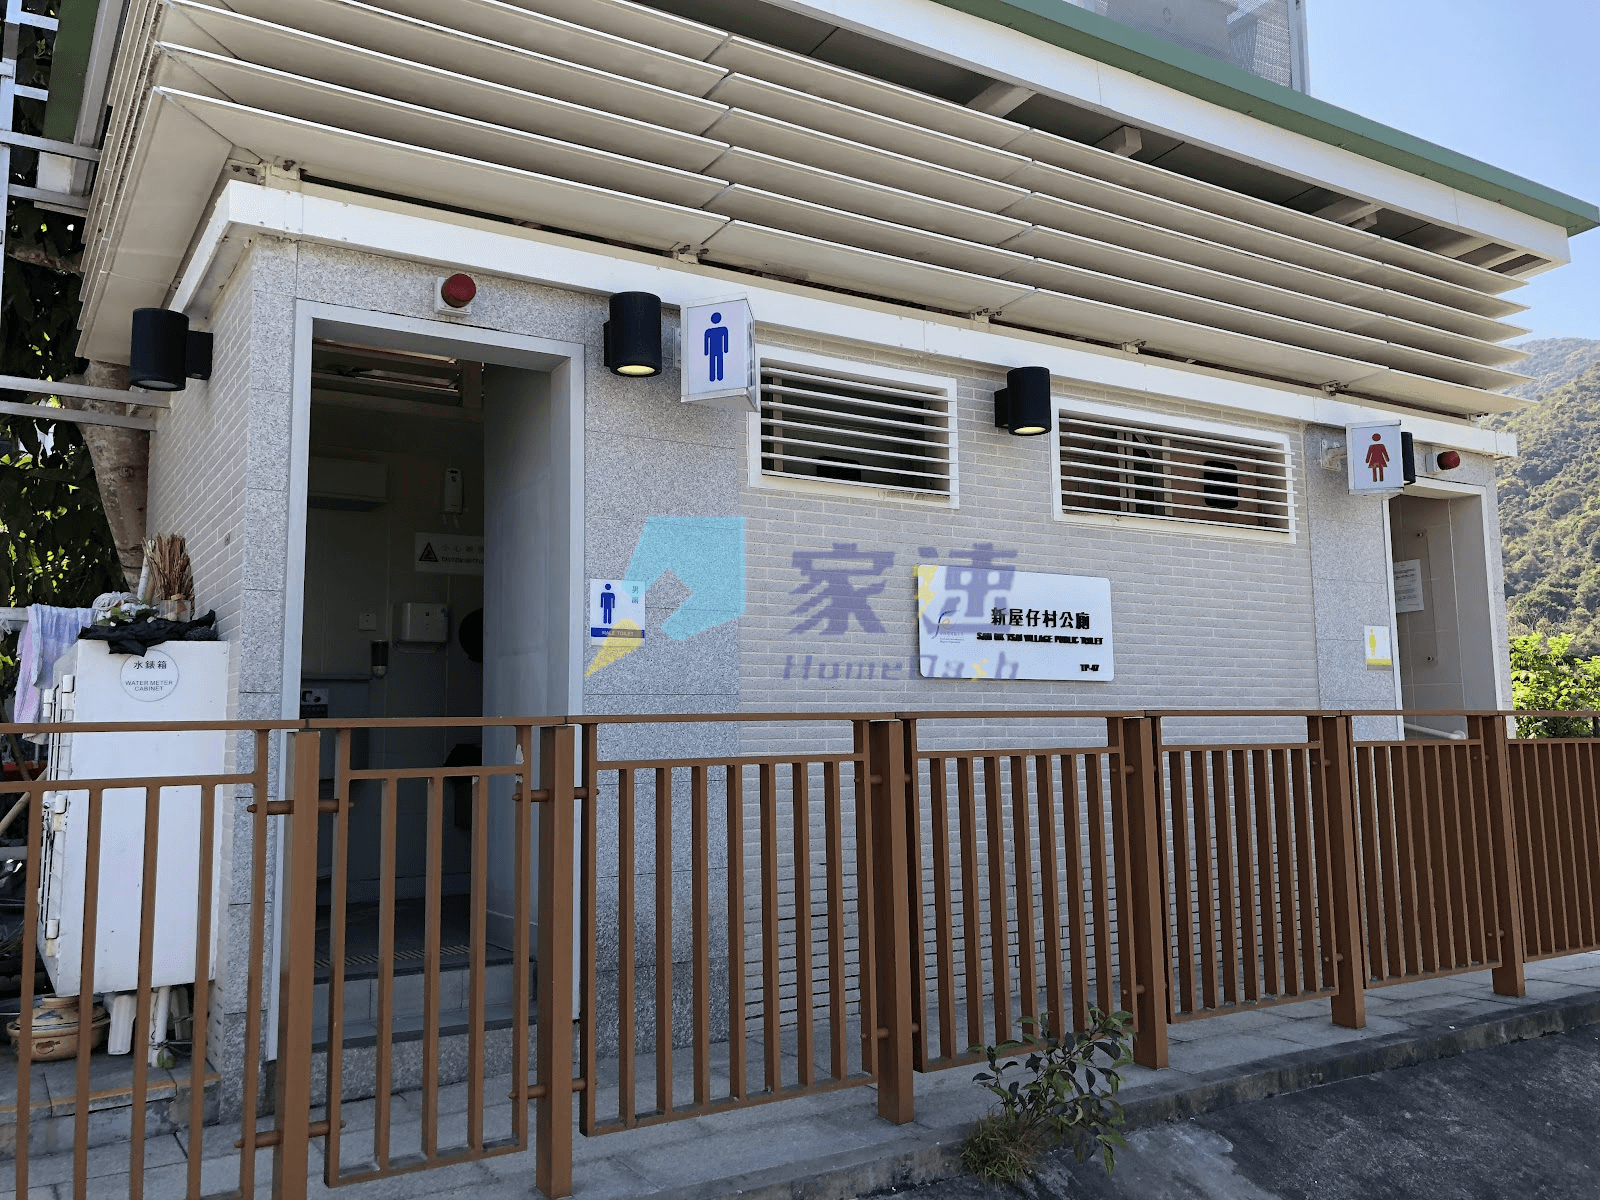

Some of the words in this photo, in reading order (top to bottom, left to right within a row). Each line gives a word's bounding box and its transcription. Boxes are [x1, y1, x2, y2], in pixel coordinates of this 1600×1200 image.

[1023, 634, 1053, 643] VILLAGE
[1054, 635, 1079, 644] PUBLIC
[1080, 637, 1104, 645] TOILET
